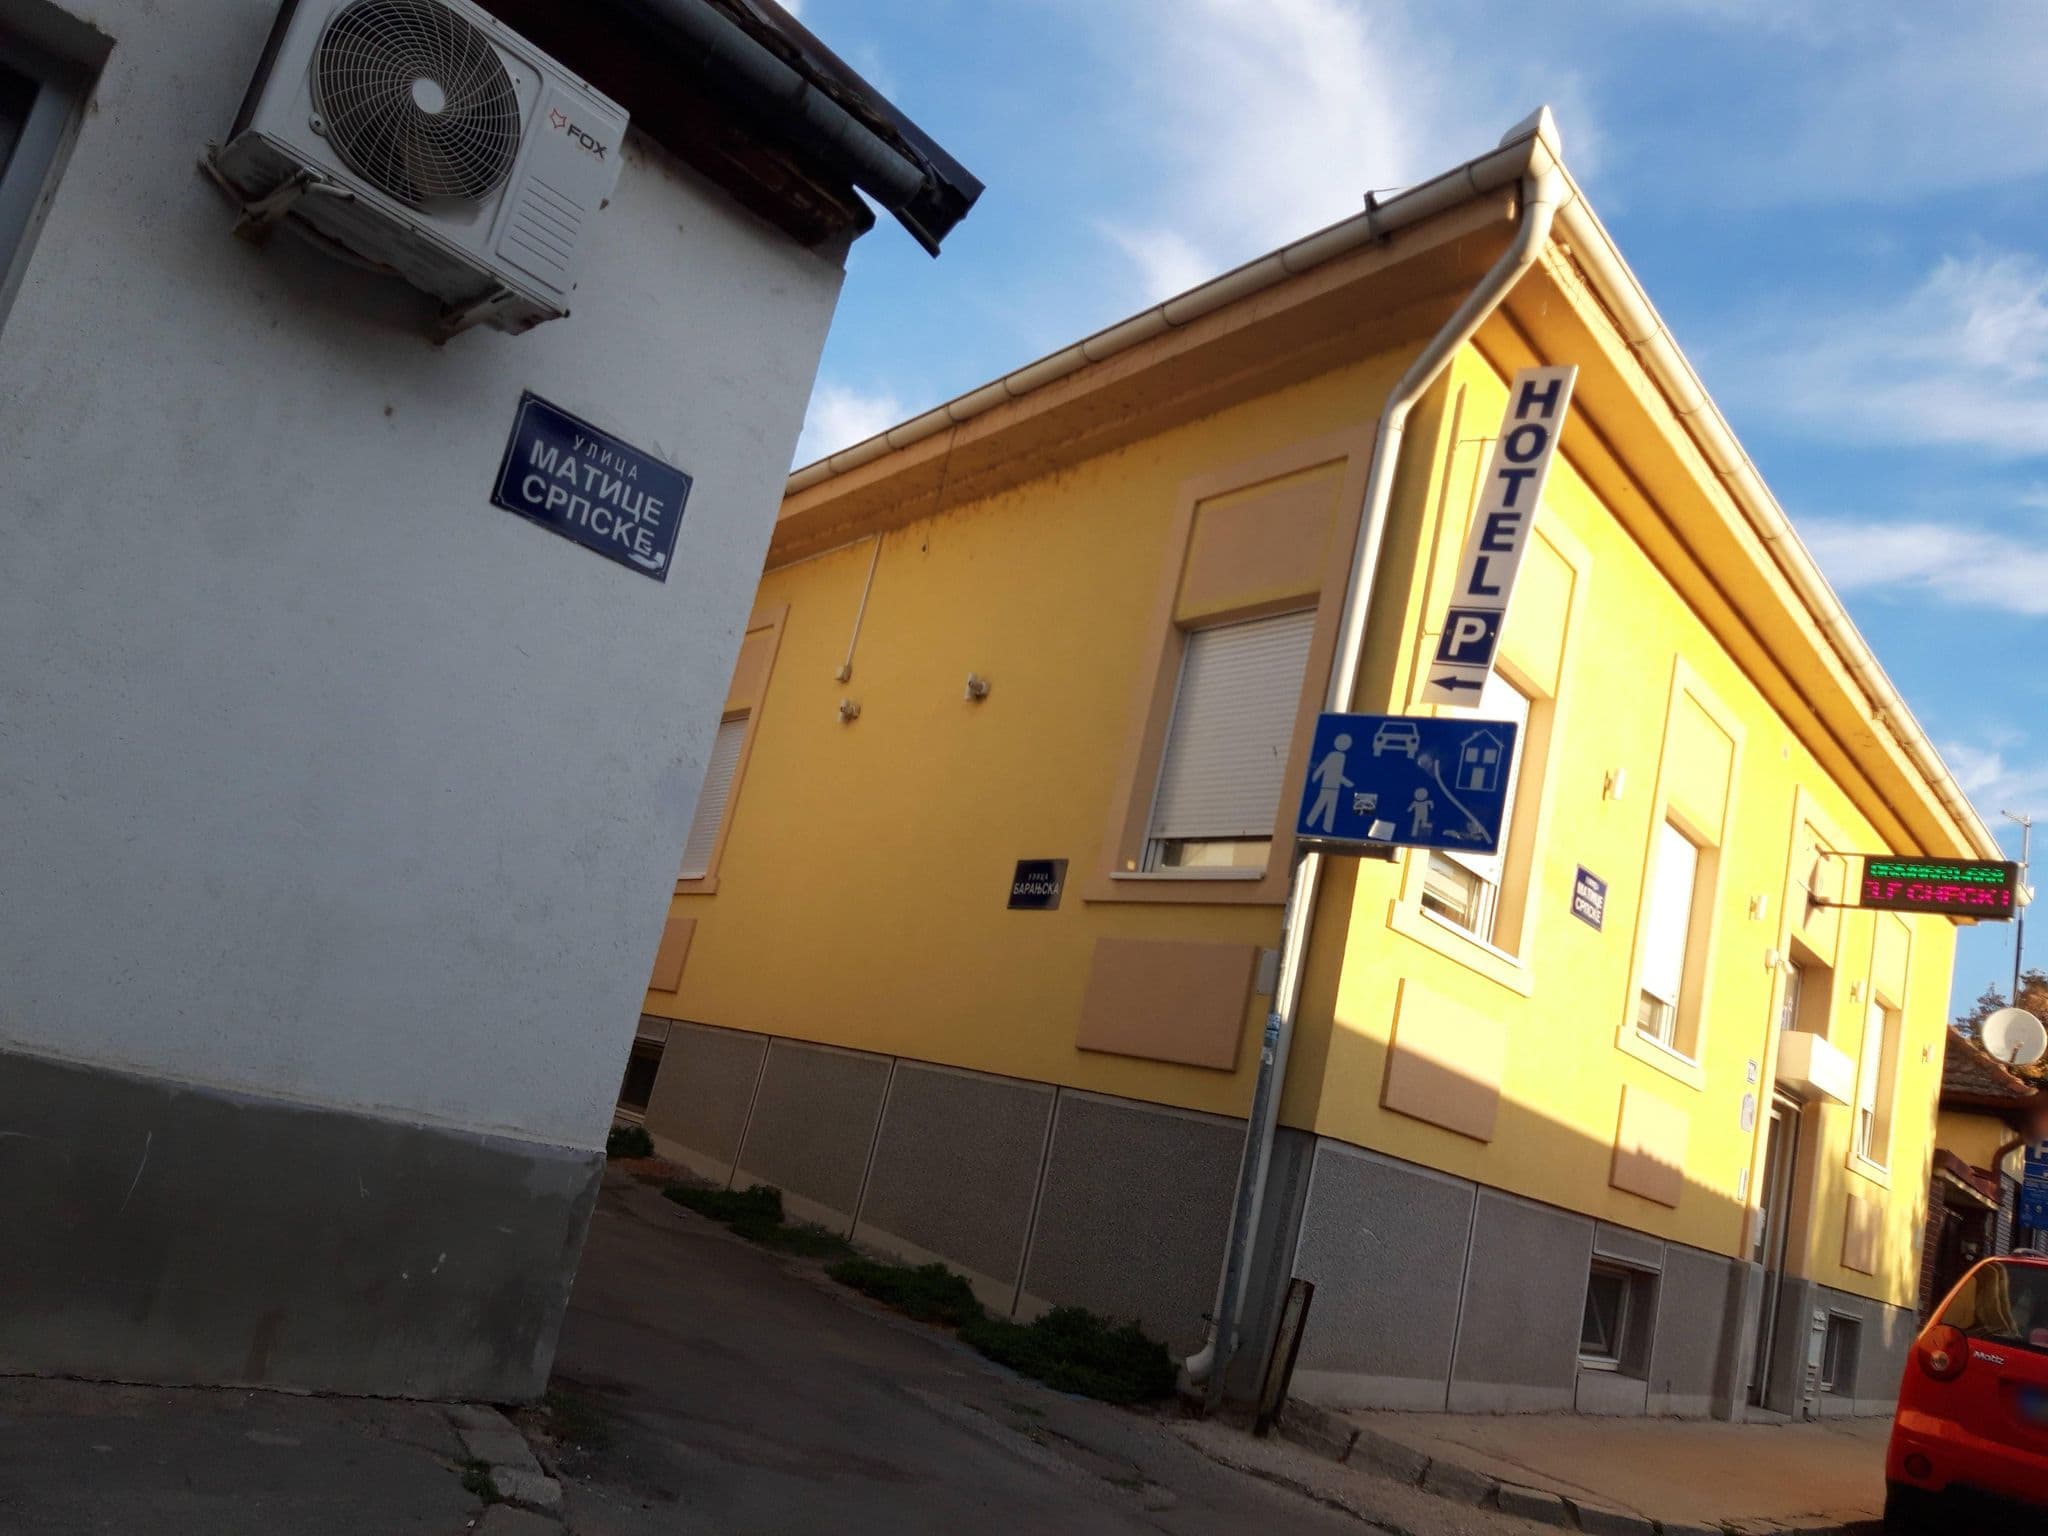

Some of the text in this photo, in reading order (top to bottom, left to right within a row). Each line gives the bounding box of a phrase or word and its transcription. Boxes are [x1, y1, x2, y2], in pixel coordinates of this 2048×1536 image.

[567, 124, 607, 159] FOX
[529, 439, 664, 526] МАТИЦЕ
[574, 434, 638, 481] УЛИЦА
[1467, 379, 1562, 596] HOTEL
[522, 475, 656, 556] СРПСКЕ
[1448, 617, 1487, 656] P
